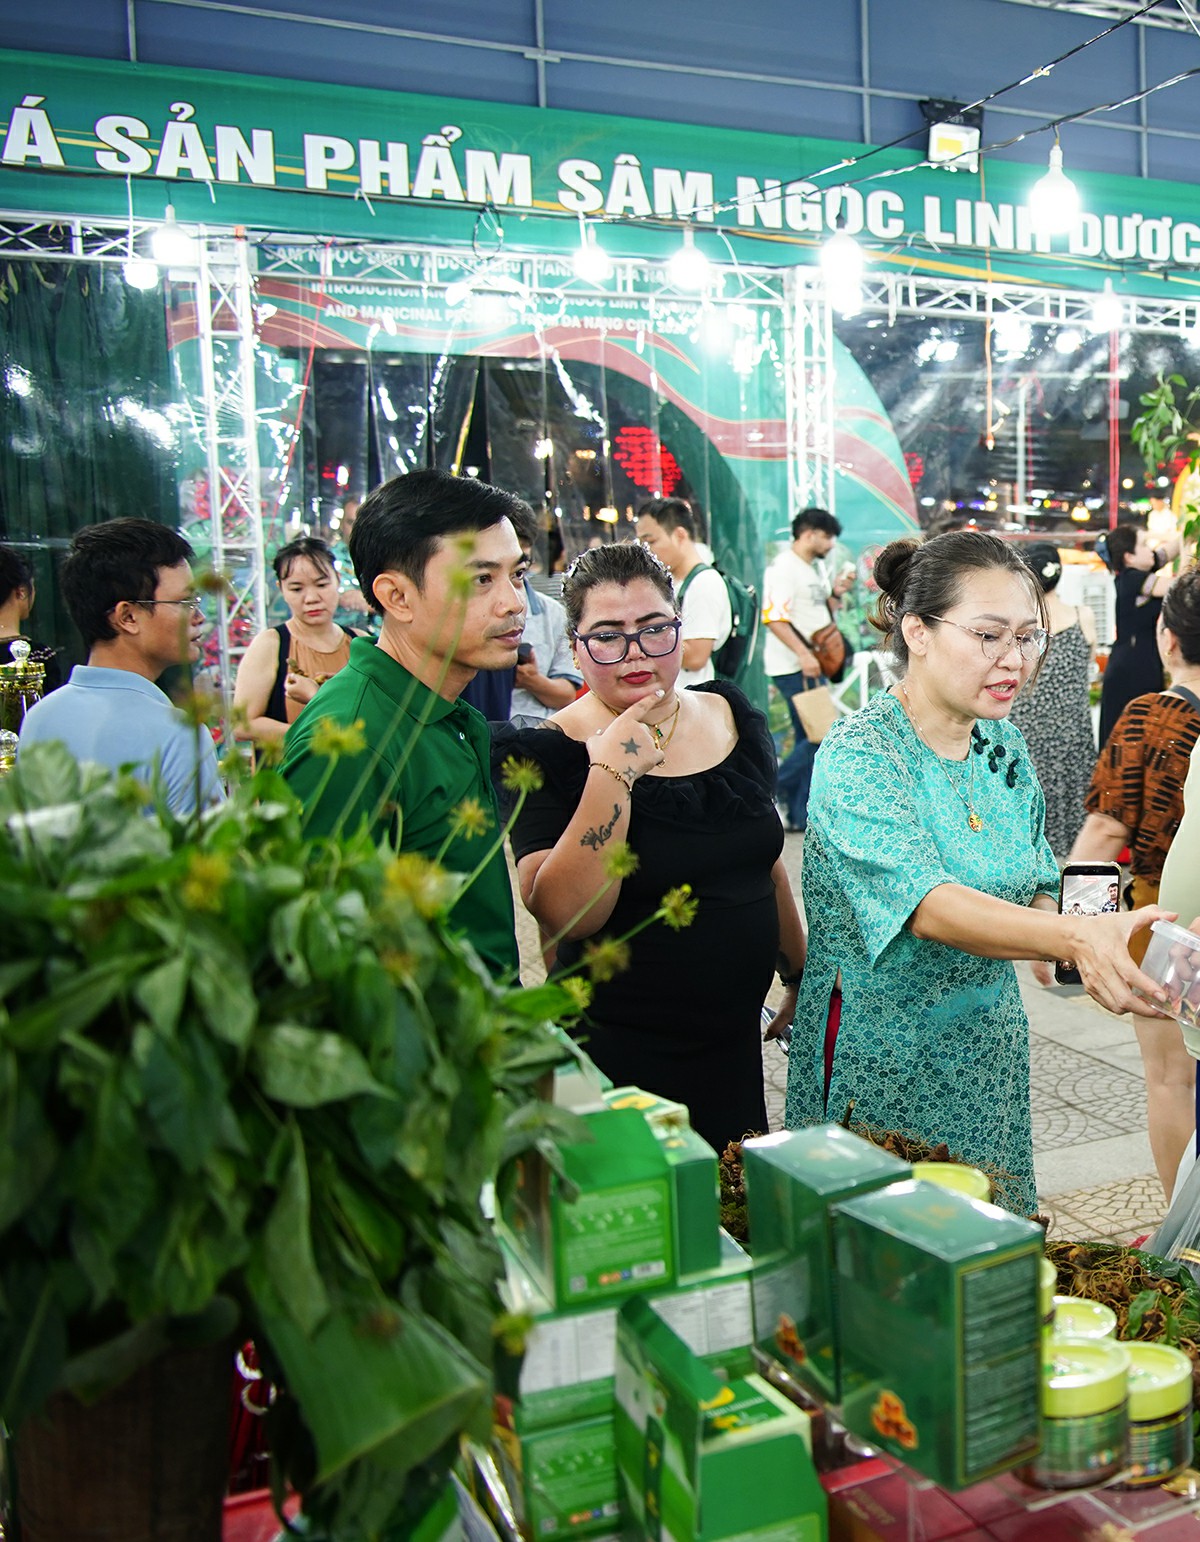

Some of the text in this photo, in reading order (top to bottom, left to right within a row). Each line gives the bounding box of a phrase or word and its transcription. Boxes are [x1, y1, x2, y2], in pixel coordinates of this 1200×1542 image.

[94, 101, 276, 186] SẢN
[303, 125, 534, 208] PHẨM
[557, 153, 716, 224] SÂM
[325, 304, 358, 319] AND
